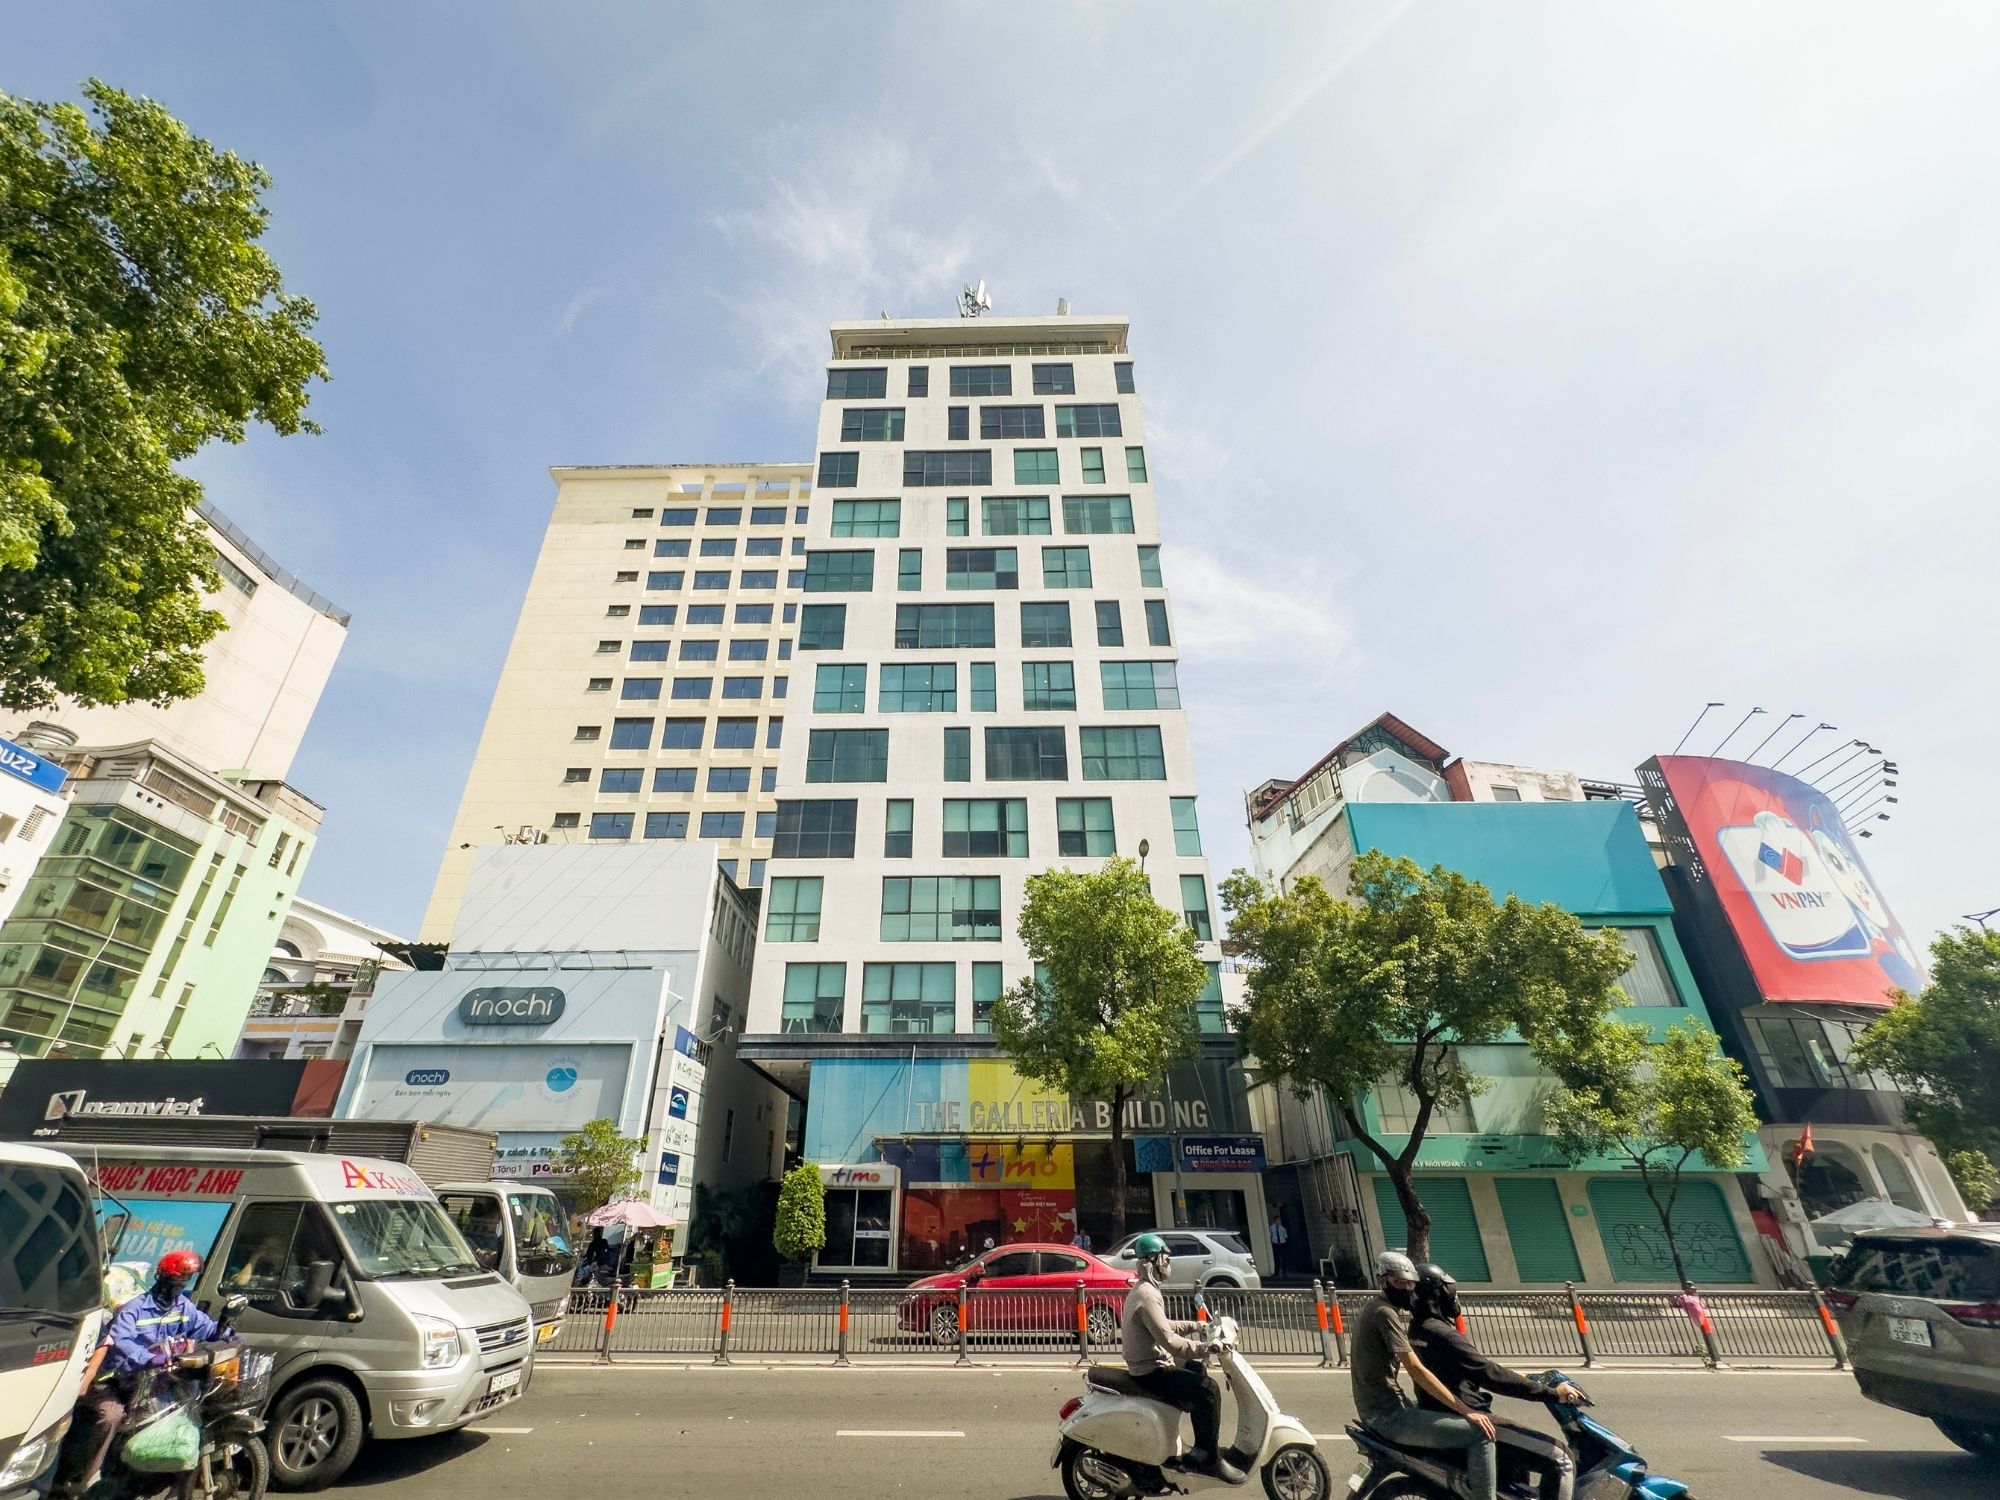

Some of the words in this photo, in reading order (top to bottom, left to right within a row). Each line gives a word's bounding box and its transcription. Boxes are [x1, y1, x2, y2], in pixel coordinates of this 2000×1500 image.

[0, 744, 37, 776] UZZ
[1769, 891, 1826, 909] VNPAY
[470, 993, 554, 1016] inochi
[410, 1071, 446, 1084] inochi
[83, 1097, 203, 1116] namviet
[916, 1102, 960, 1129] THE
[969, 1101, 1086, 1130] GALLERIA
[1185, 1145, 1213, 1155] Office
[1213, 1145, 1228, 1155] For
[1229, 1145, 1256, 1155] Lease
[971, 1152, 1058, 1178] timo
[141, 1167, 199, 1197] NGỌC
[195, 1168, 244, 1194] ANH
[32, 1349, 69, 1365] 270
